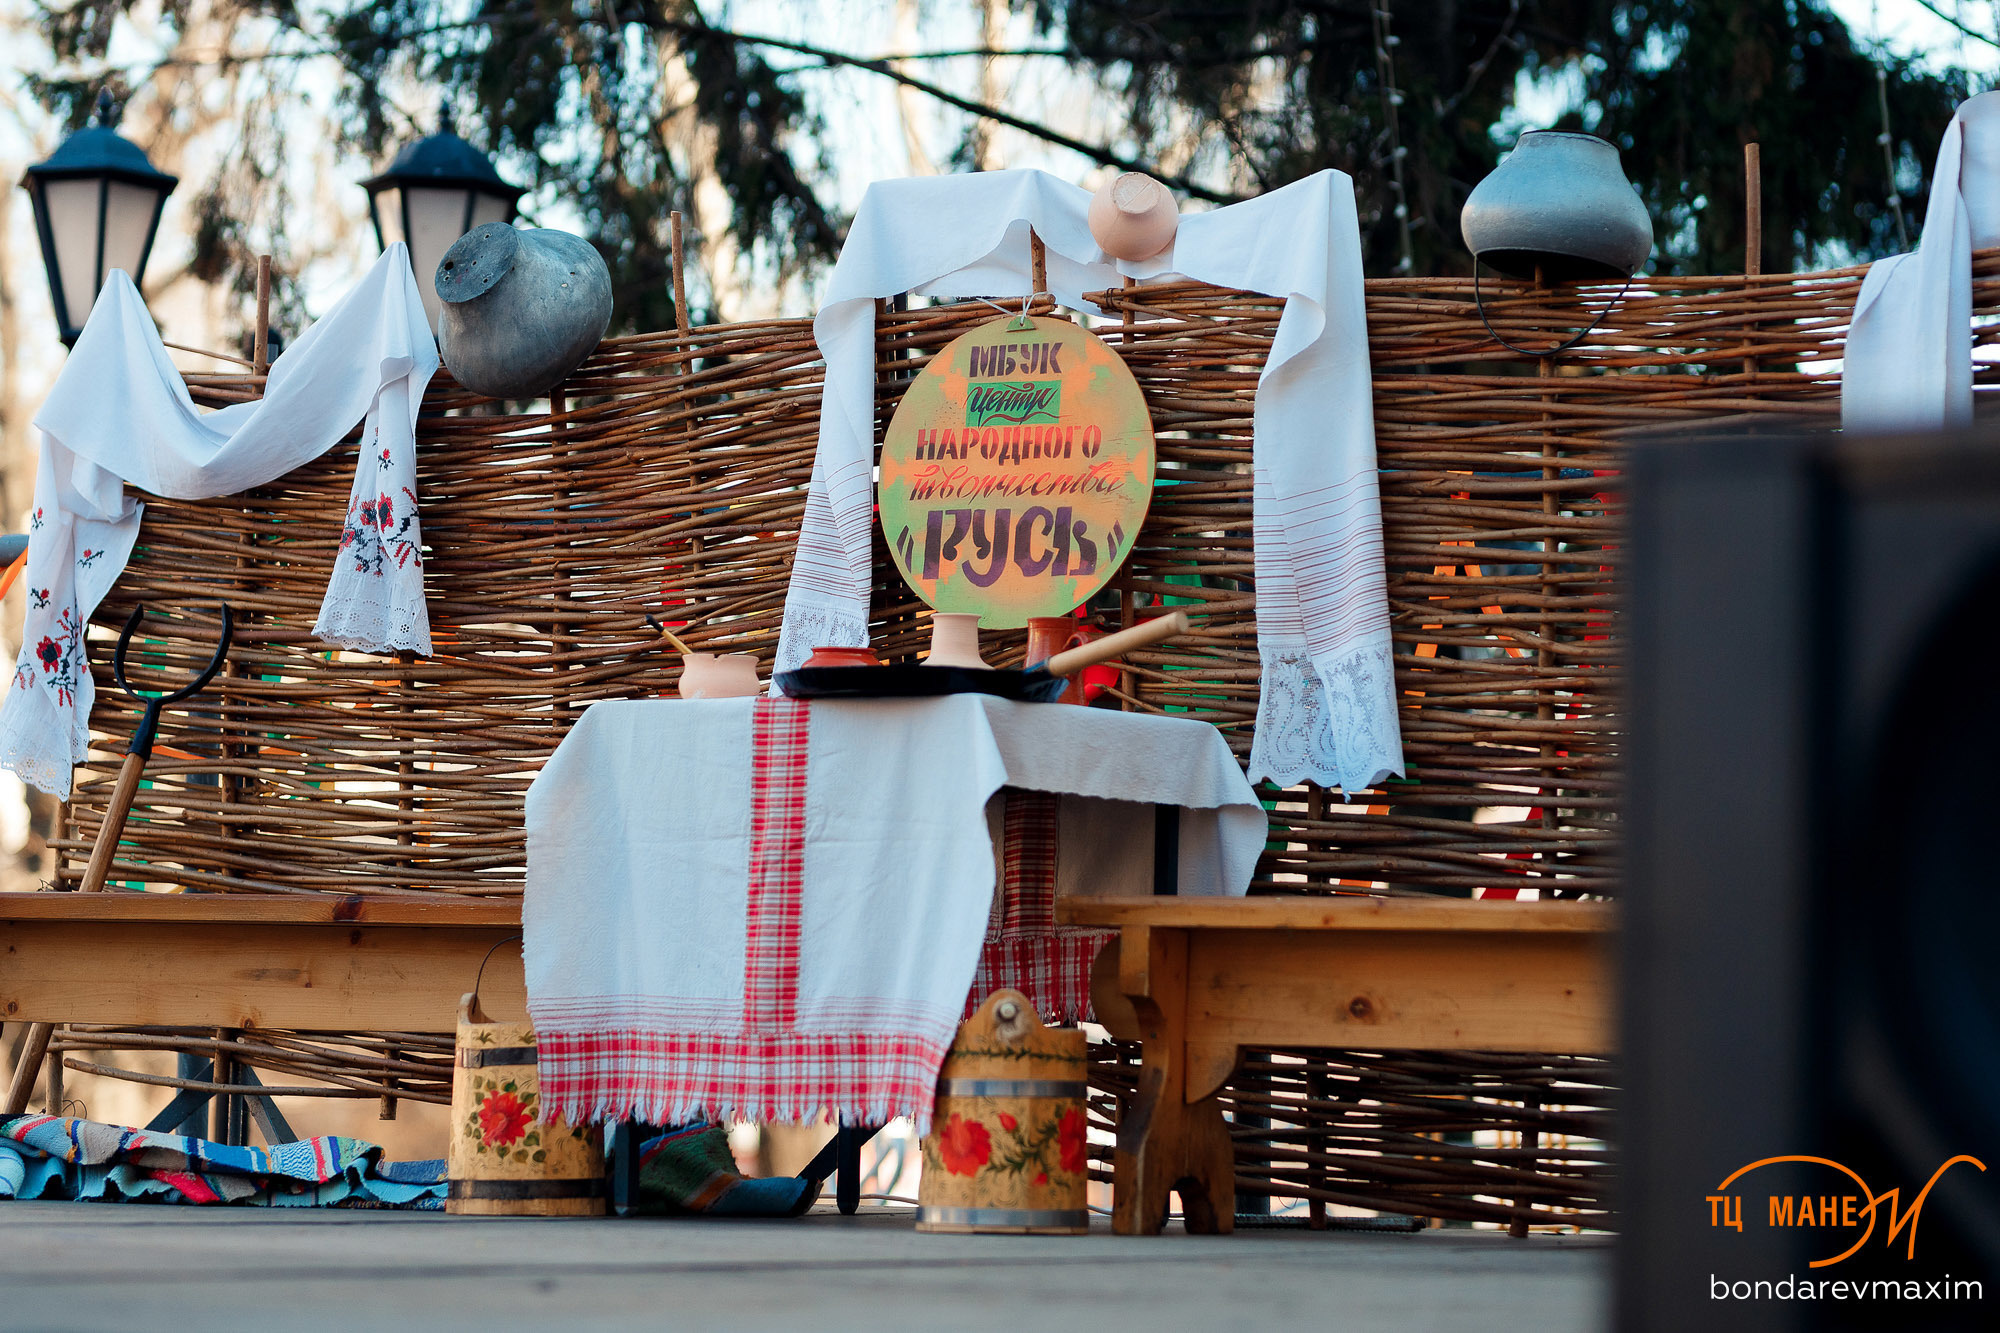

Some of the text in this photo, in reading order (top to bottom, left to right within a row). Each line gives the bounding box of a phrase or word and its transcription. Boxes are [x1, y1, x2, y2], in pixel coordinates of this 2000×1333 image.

[969, 342, 1063, 378] МБУК
[915, 425, 1102, 465] НАРОДНОГО
[910, 461, 1126, 505] творчества
